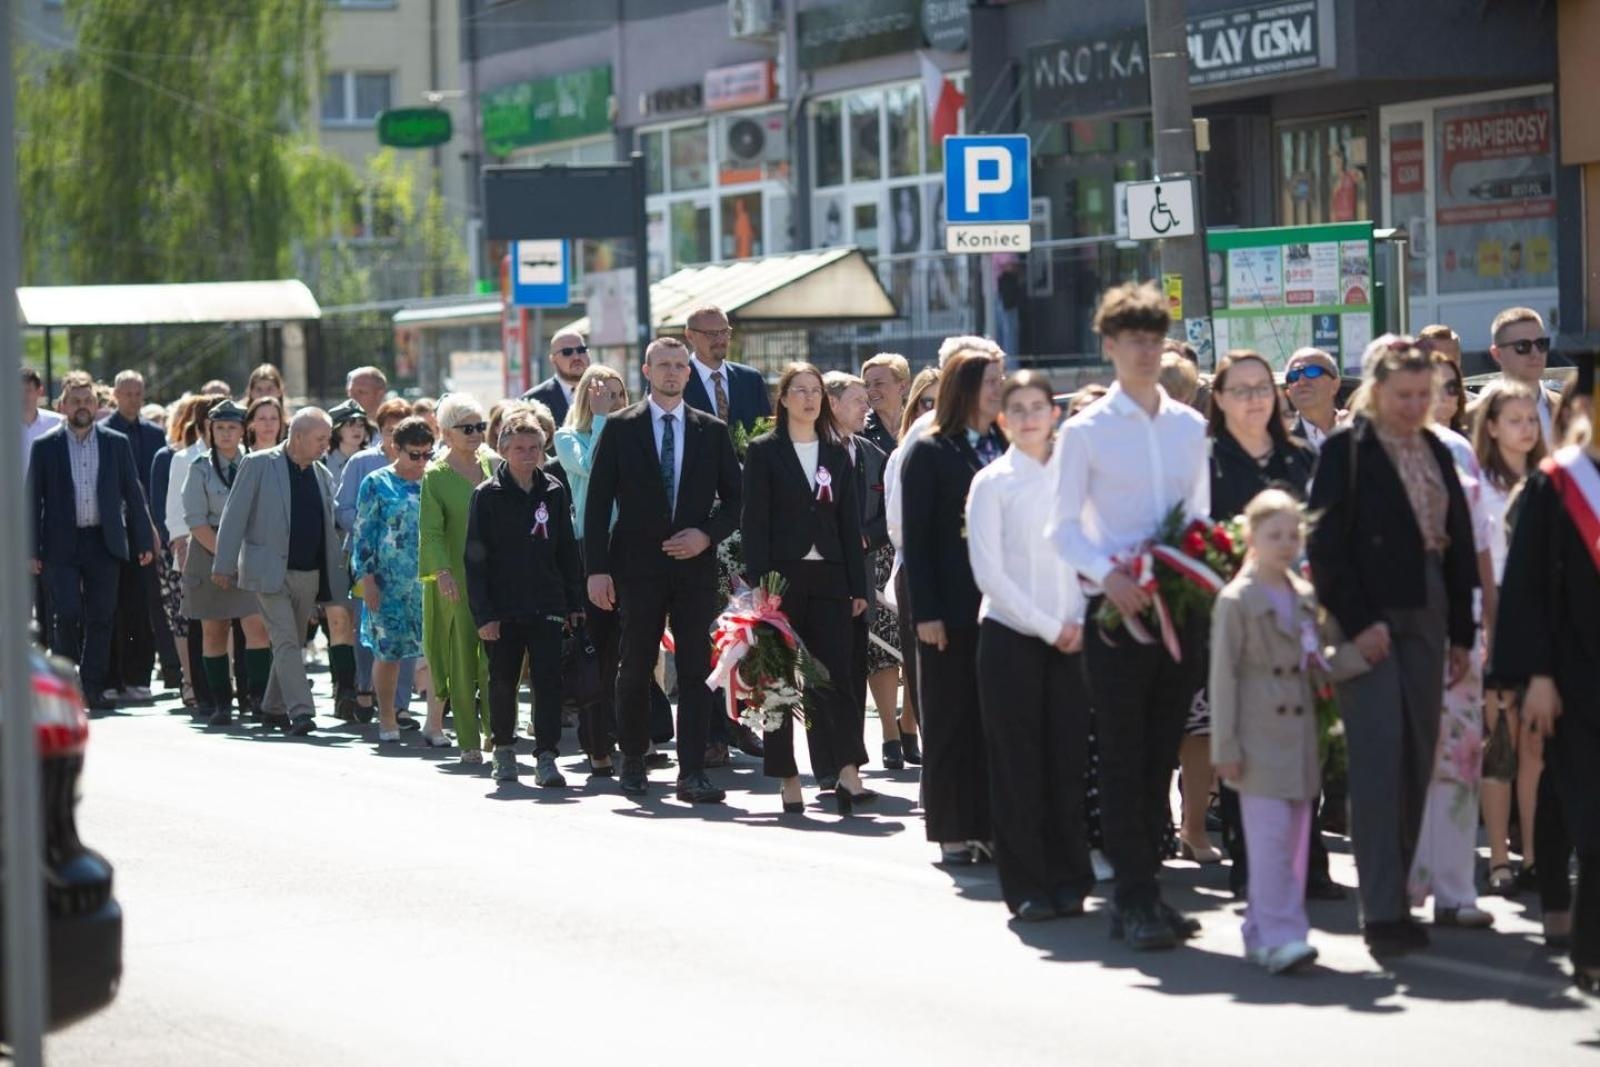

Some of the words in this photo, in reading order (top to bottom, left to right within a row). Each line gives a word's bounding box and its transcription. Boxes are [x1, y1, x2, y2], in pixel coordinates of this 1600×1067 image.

[1251, 14, 1311, 60] GSM
[1446, 114, 1548, 150] E-PAPIEROSY
[963, 146, 1013, 213] P
[956, 231, 1021, 247] Koniec
